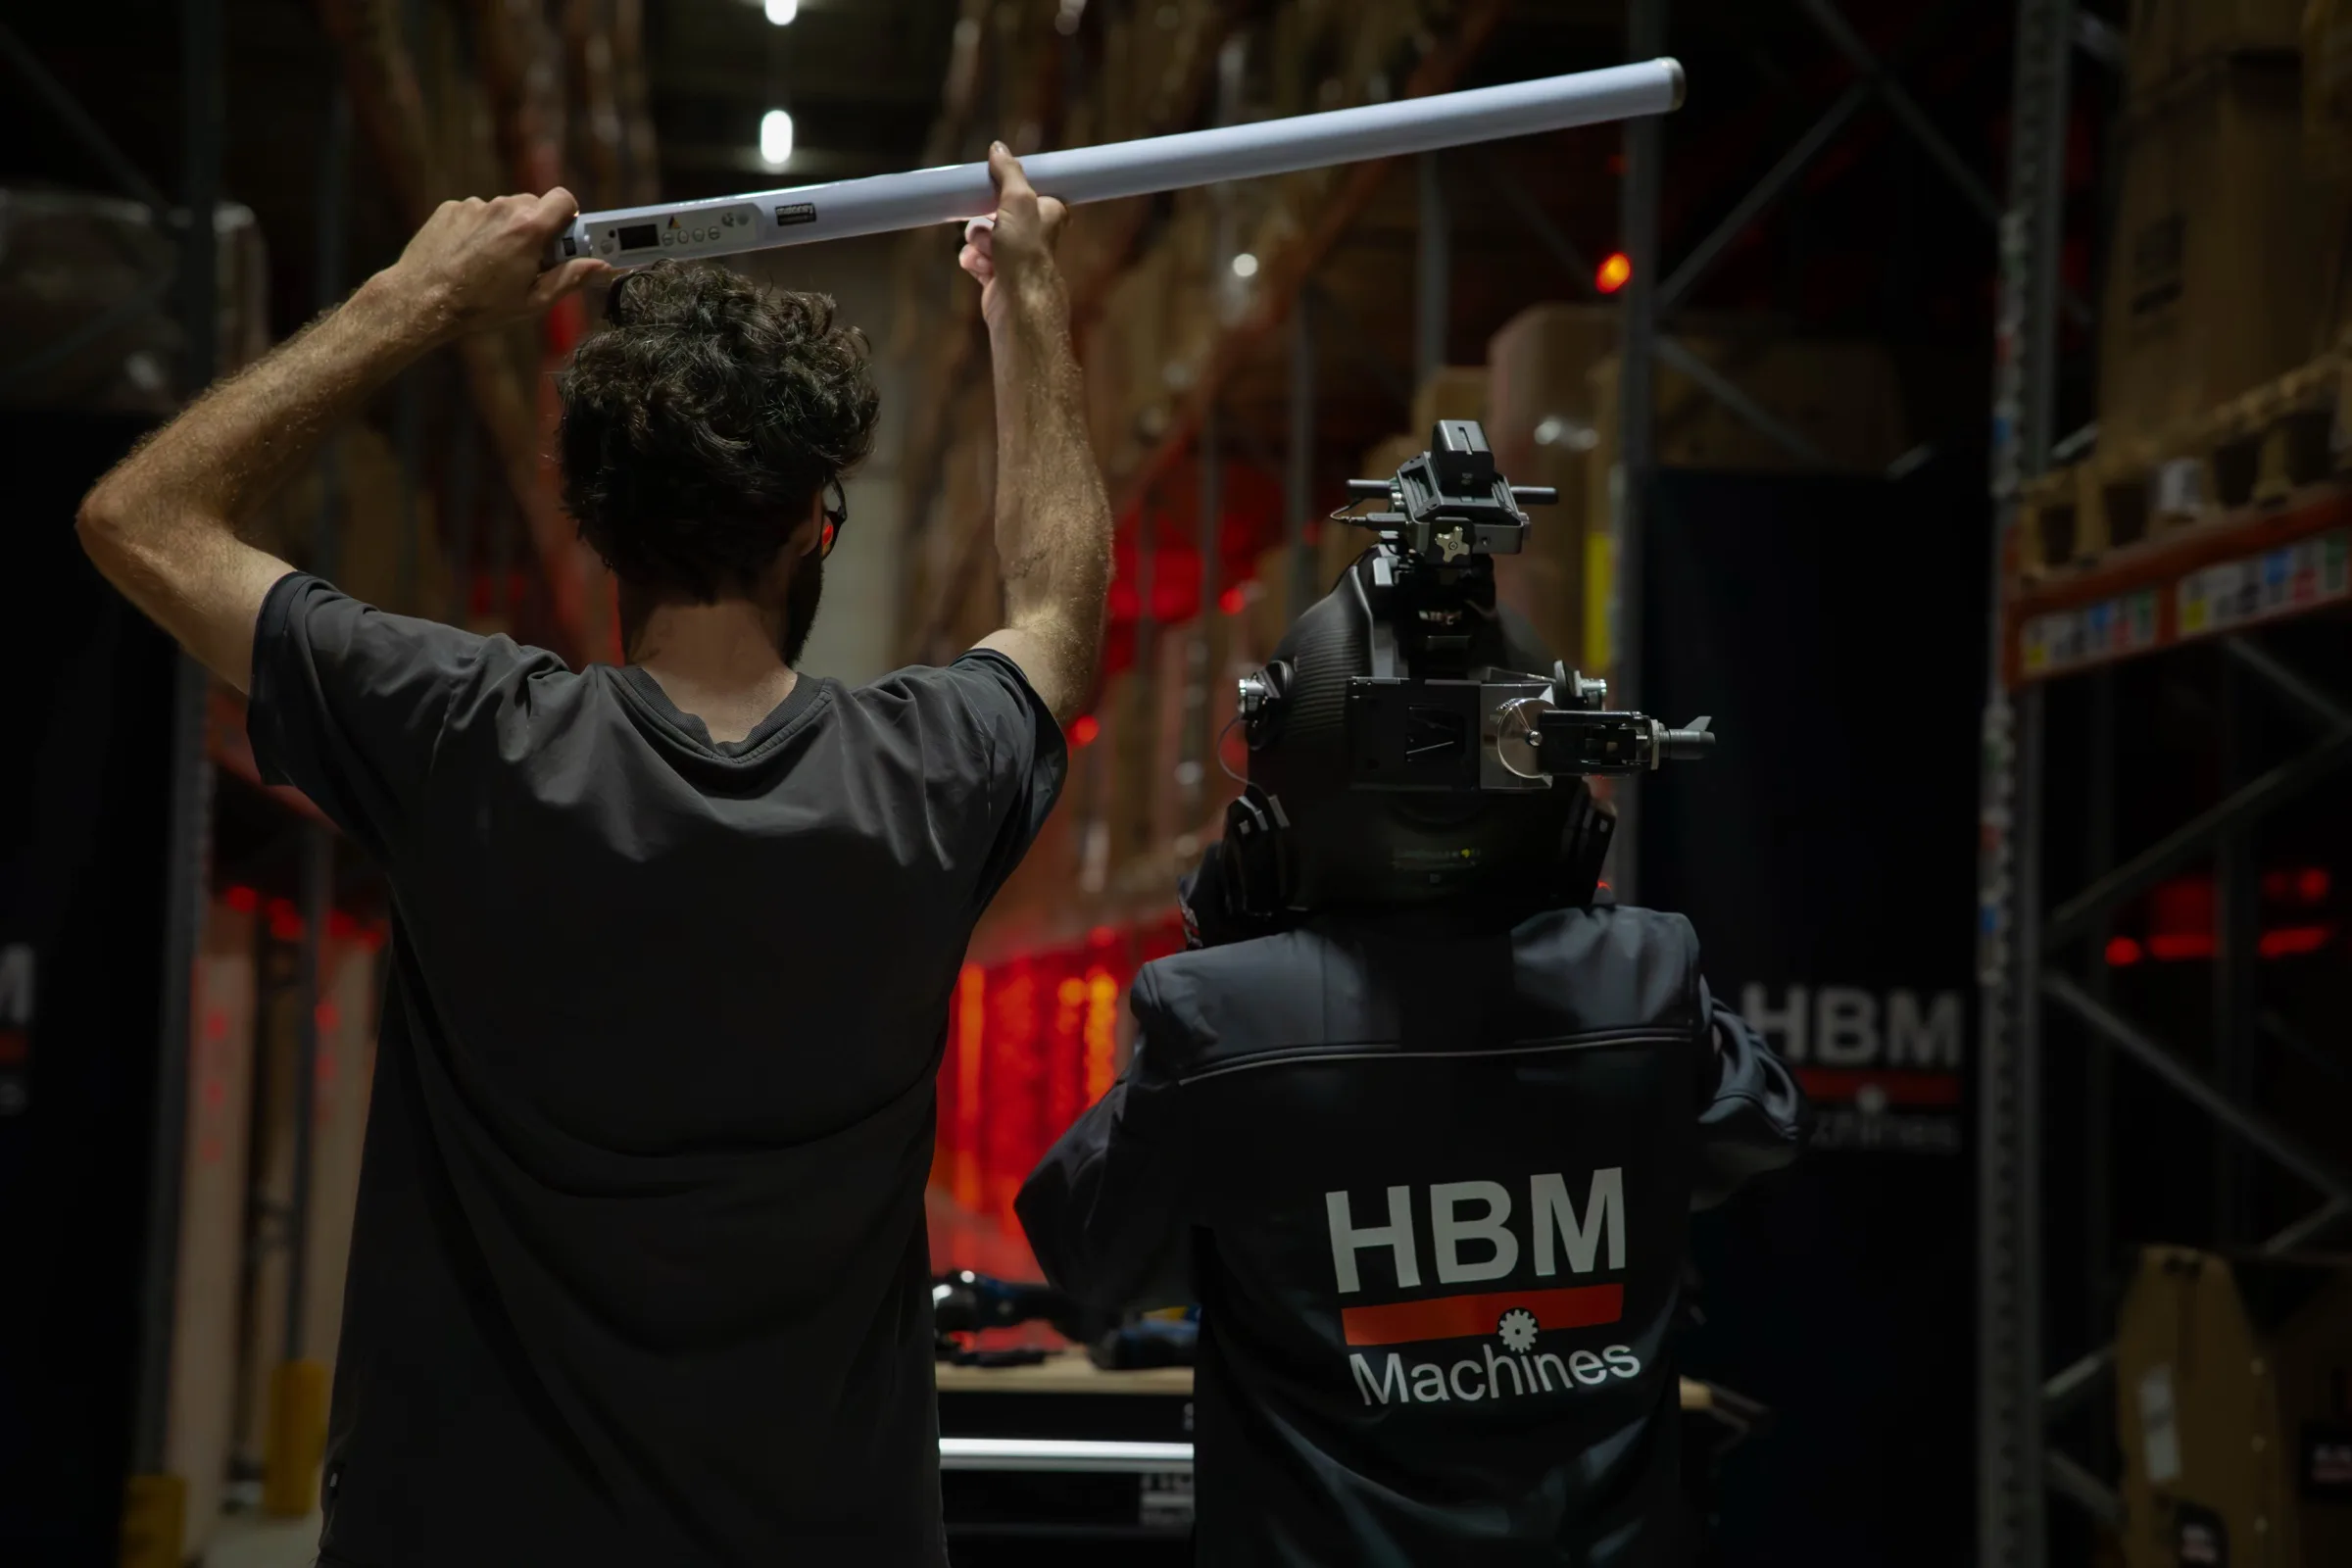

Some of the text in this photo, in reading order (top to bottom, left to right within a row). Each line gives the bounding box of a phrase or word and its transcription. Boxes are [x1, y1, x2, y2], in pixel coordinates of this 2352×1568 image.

[1741, 982, 1965, 1066] HBM
[1325, 1166, 1627, 1294] HBM
[1348, 1342, 1642, 1406] Machines
